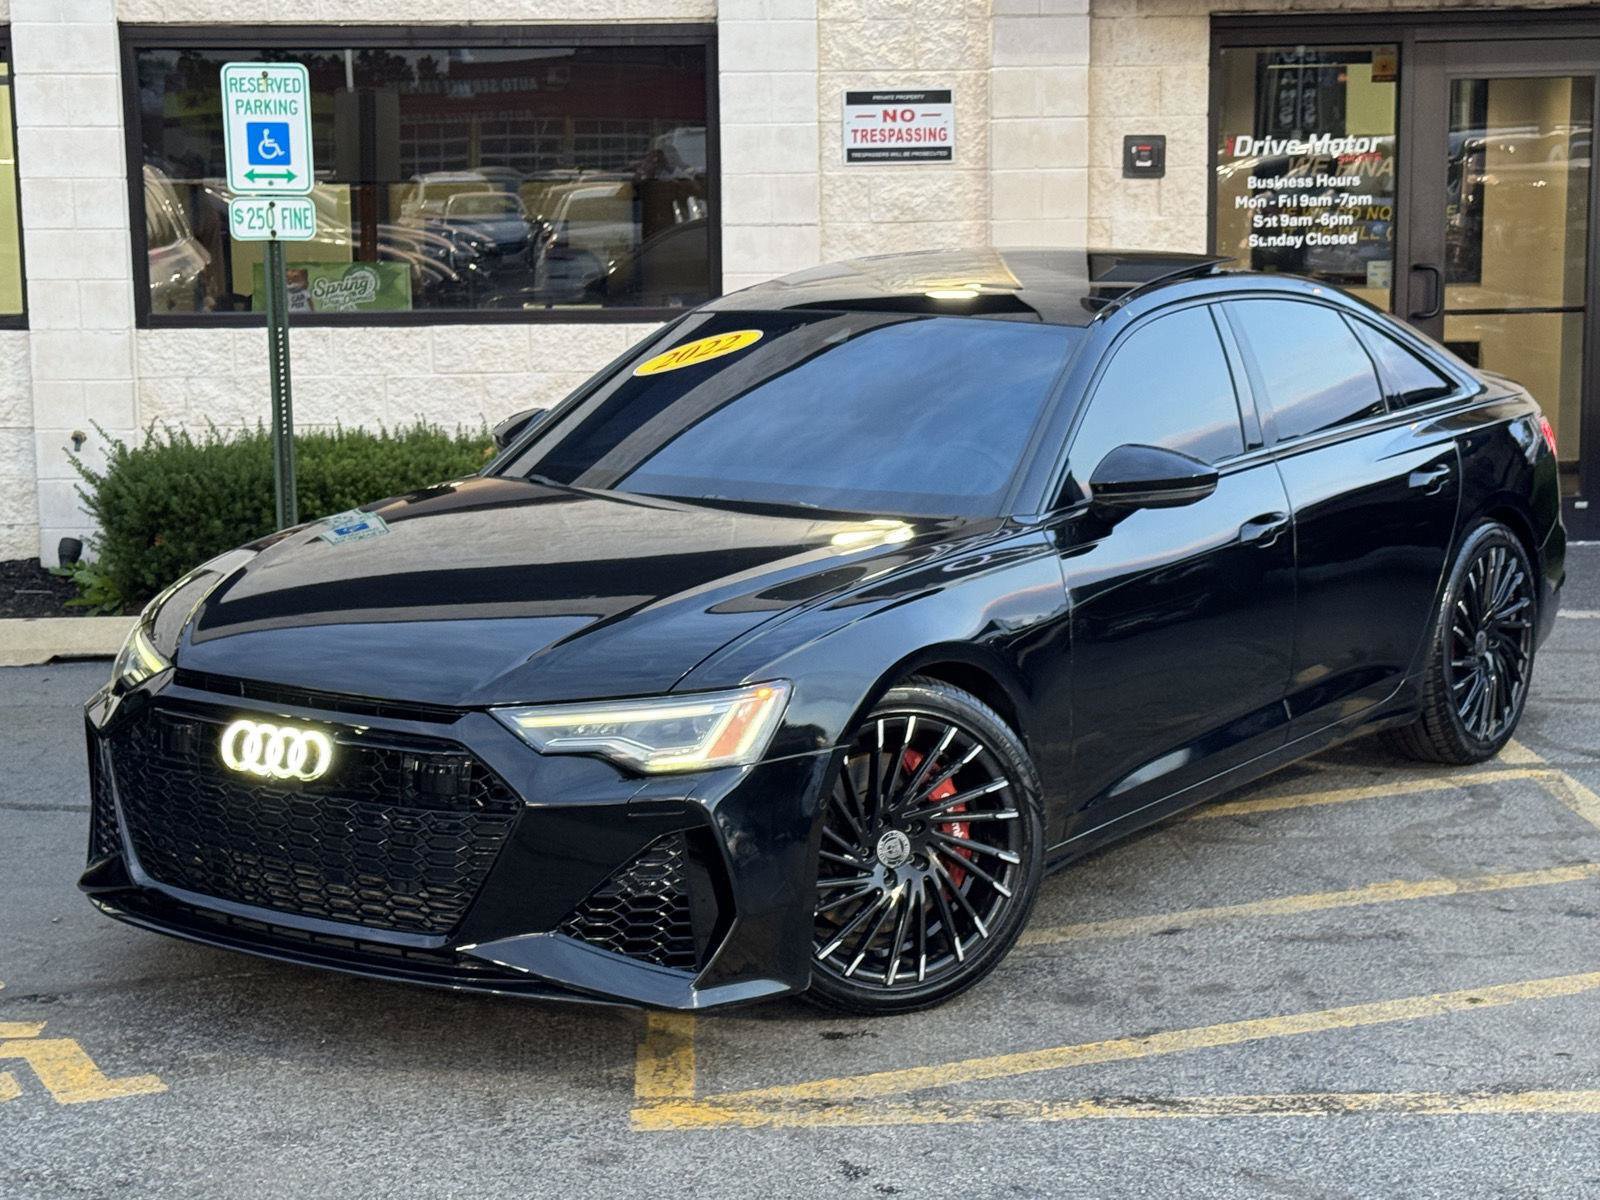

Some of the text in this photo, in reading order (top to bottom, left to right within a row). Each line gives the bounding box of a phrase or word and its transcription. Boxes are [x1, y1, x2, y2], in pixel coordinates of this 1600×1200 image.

[229, 77, 301, 93] RESERVED
[235, 99, 299, 116] PARKING
[882, 109, 915, 123] NO
[851, 127, 948, 143] TRESPASSING
[1307, 133, 1382, 156] Motor
[1247, 174, 1361, 190] Business Hours
[1235, 194, 1267, 209] Mon
[1278, 194, 1298, 208] Fri
[1299, 193, 1332, 207] 9am
[234, 207, 312, 229] $250 FINE
[1253, 213, 1279, 229] Sat
[1280, 213, 1313, 227] 9am
[1248, 232, 1303, 249] Sunday
[1305, 231, 1358, 246] Closed
[313, 275, 368, 298] Spring
[652, 334, 742, 371] 2022
